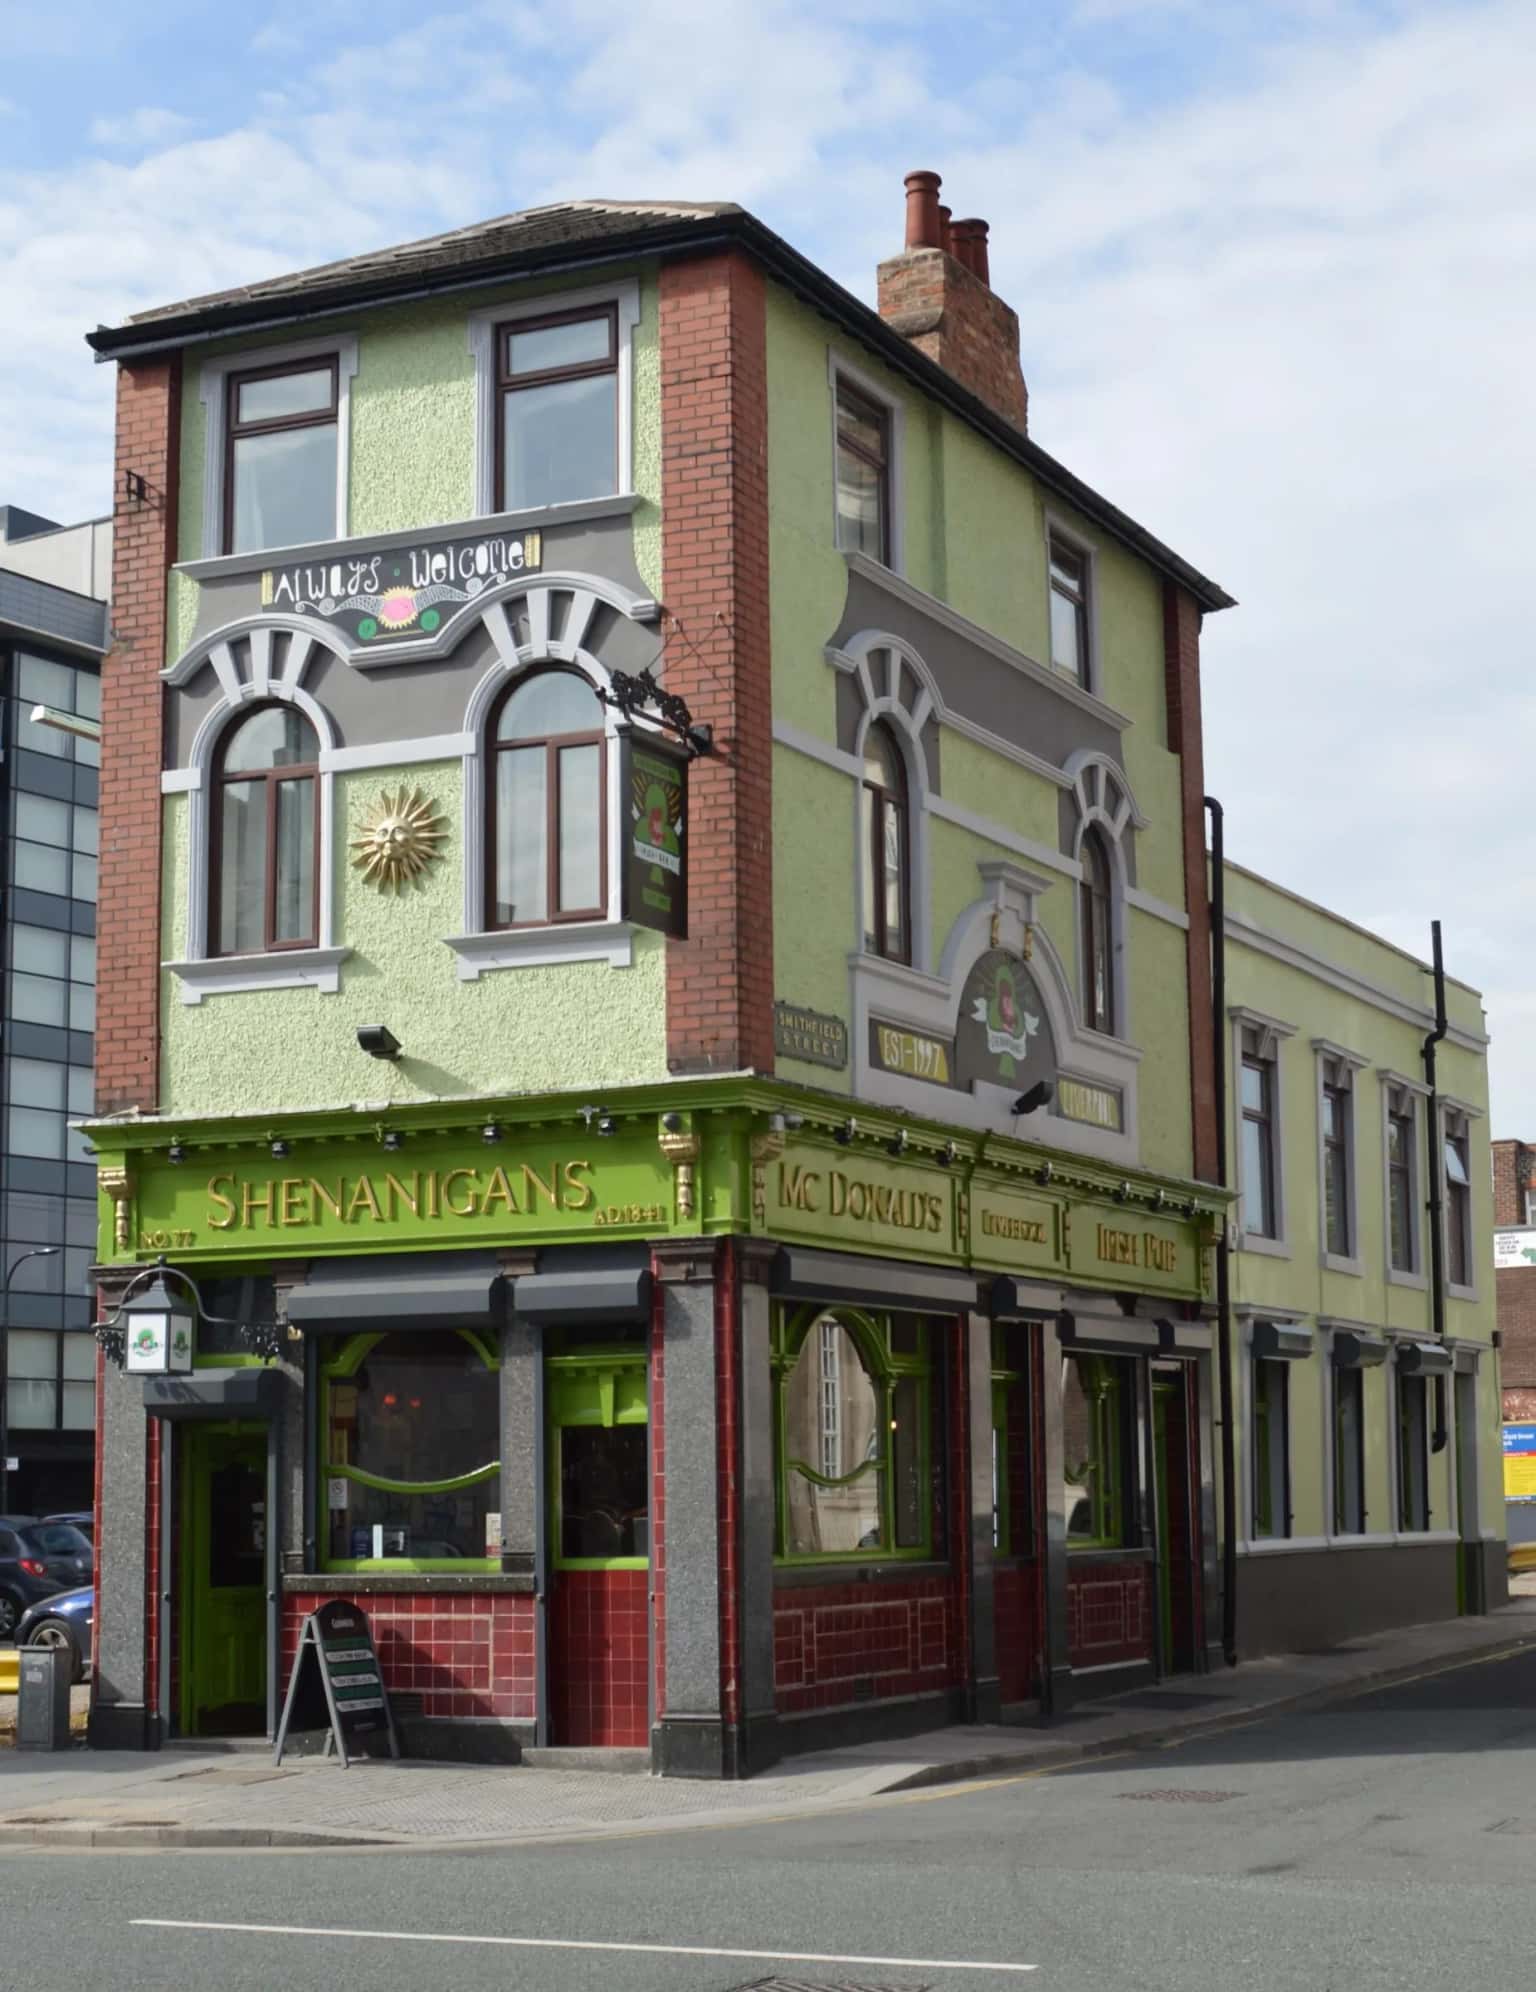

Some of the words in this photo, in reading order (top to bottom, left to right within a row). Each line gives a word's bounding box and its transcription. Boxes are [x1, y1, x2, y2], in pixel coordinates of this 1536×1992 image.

[409, 539, 524, 587] Welcome
[778, 1011, 842, 1041] SMITHFIELD
[783, 1033, 838, 1057] STREET
[207, 1160, 592, 1228] SHENANIGANS
[1097, 1222, 1139, 1266] IRISH
[1143, 1232, 1177, 1273] PUB
